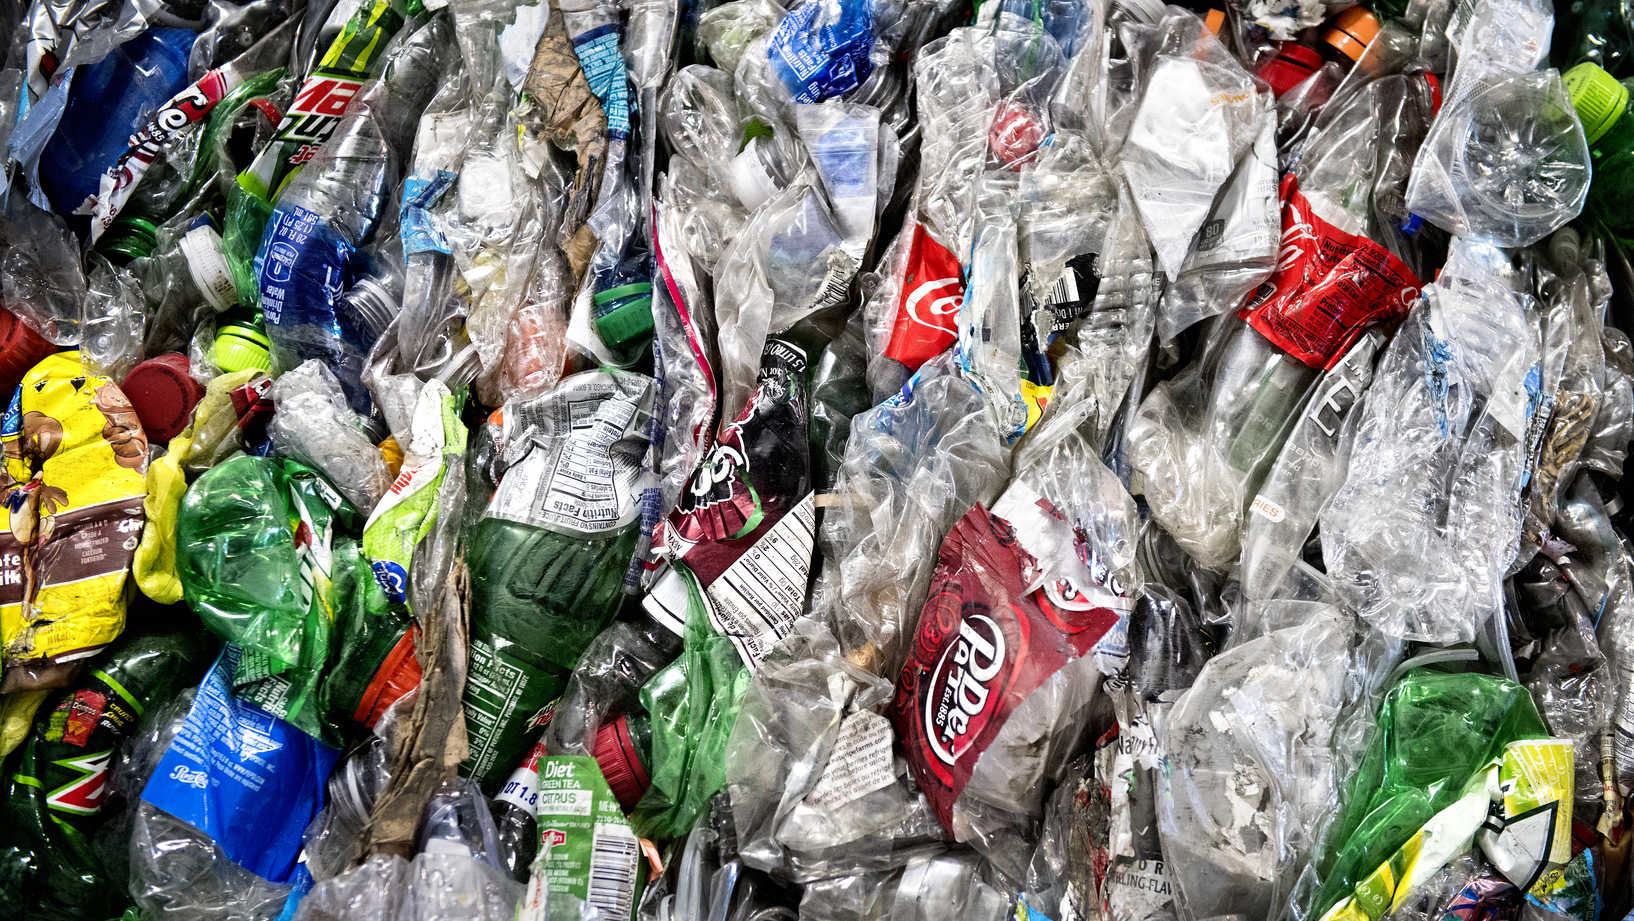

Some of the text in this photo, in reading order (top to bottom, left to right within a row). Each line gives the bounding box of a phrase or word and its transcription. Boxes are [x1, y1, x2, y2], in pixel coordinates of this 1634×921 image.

[798, 49, 816, 71] Facts
[302, 211, 319, 224] 591
[278, 226, 289, 236] OZ
[1206, 223, 1219, 237] 80
[295, 234, 308, 245] 20
[266, 285, 285, 300] Water
[770, 343, 797, 363] LITRO
[553, 501, 580, 516] Facts
[254, 677, 277, 703] Facts
[935, 702, 949, 727] 1885
[545, 761, 576, 778] Diet
[541, 780, 581, 789] GREEN TEA
[542, 793, 577, 804] CITRUS
